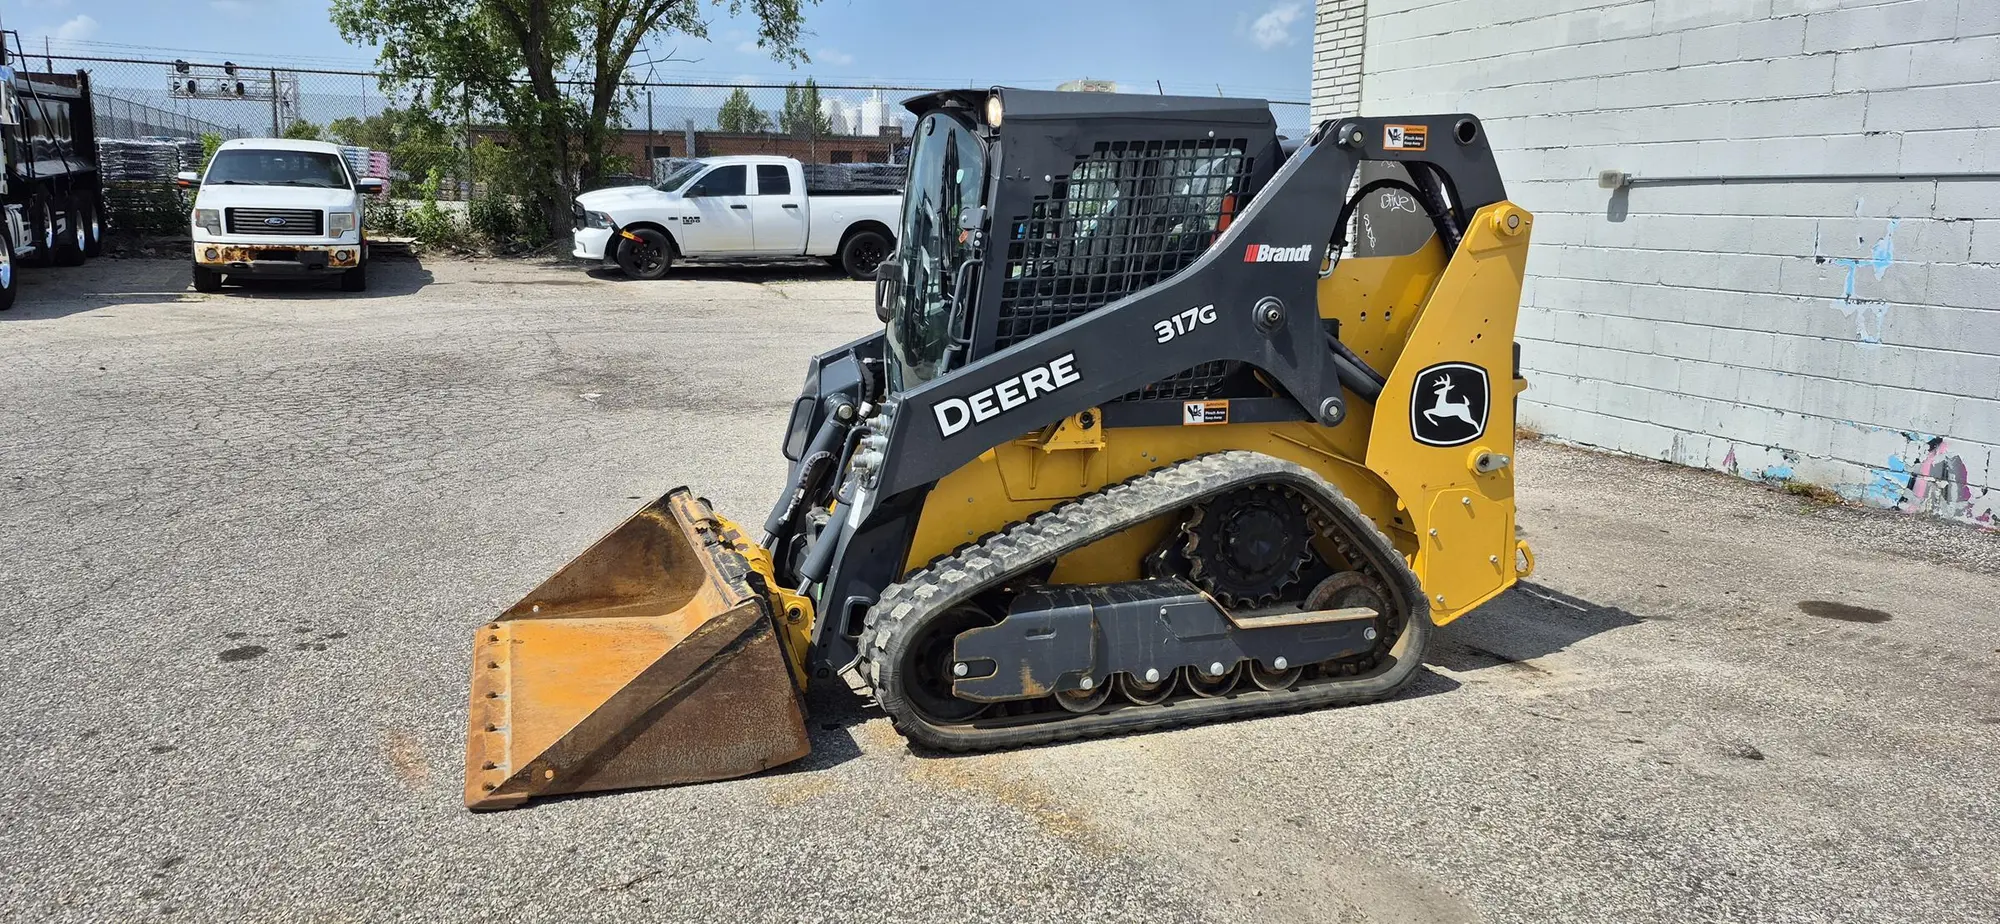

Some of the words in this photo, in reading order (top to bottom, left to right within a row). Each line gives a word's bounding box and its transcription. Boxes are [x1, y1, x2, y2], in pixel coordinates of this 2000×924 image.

[1256, 244, 1312, 262] Brandt
[1153, 304, 1218, 344] 317G
[933, 353, 1081, 438] DEERE
